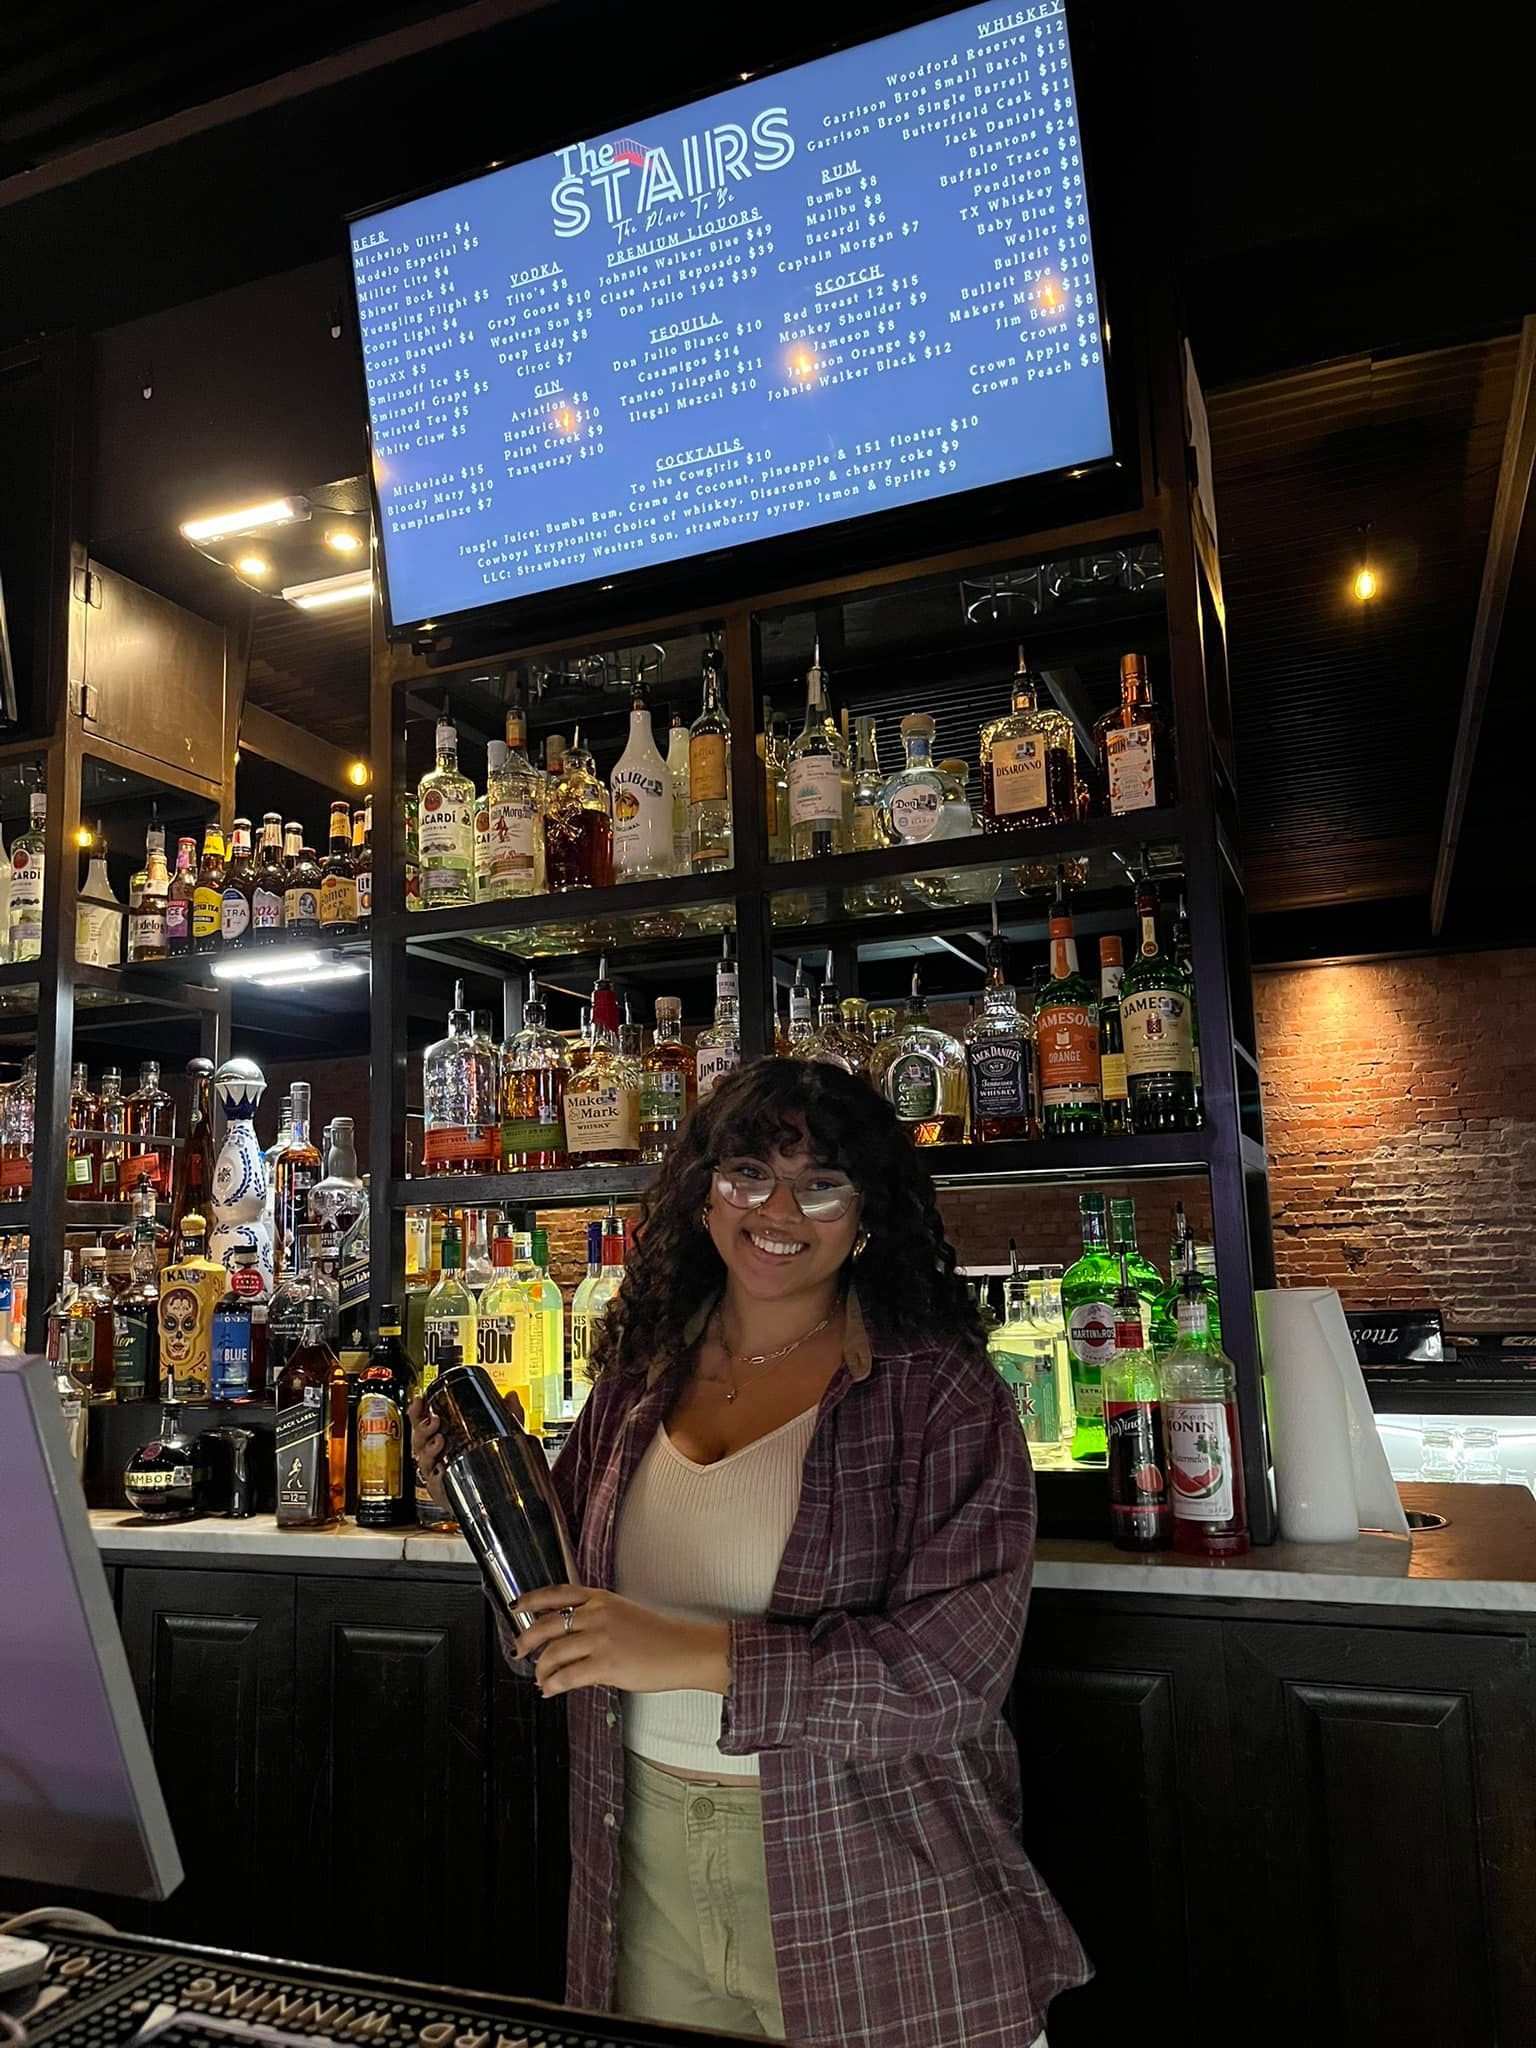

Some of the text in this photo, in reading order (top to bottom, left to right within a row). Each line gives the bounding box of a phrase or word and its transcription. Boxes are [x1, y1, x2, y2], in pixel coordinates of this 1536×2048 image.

[977, 0, 1063, 38] WHISKEY
[886, 20, 1064, 87] Woodford Reserve $12
[823, 39, 1065, 127] Garrison Bros Small Batch $15
[945, 96, 1072, 147] Jack Daniels $8
[551, 107, 795, 238] STAIRS
[554, 141, 615, 181] The
[821, 160, 861, 184] RUM
[940, 135, 1077, 187] Buffalo Trace $8
[806, 175, 877, 207] Bumbu $8
[806, 193, 882, 226] Malibu $8
[959, 174, 1081, 221] TX Whiskey $8
[612, 218, 638, 245] The
[691, 191, 712, 219] To
[716, 188, 736, 210] Be
[806, 211, 886, 245] Bacardi $6
[1004, 214, 1085, 247] Weller $8
[353, 231, 388, 251] BEER
[355, 221, 470, 268] Michelob Ultra $4
[599, 223, 772, 288] Johnnie Walker Blue $49
[607, 208, 761, 266] PREMIUM LIQUORS
[778, 220, 919, 273] Captain Morgan $7
[356, 237, 479, 286] Modelo Especial $5
[510, 262, 562, 287] VODKA
[600, 242, 774, 305] Clase Azul Reposado $39
[815, 264, 882, 295] SCOTCH
[358, 265, 449, 303] Miller Lite $4
[360, 281, 455, 320] Shiner Bock $4
[506, 278, 568, 306] Tito's $8
[783, 274, 918, 324] Red Breast 12 $15
[488, 289, 591, 330] Grey Goose $10
[490, 308, 592, 348] Western Son $5
[649, 312, 721, 343] TEQUILA
[779, 291, 927, 343] Monkey Shoulder $9
[638, 345, 739, 383] Casamigos $14
[969, 332, 1098, 376] Crown Apple $8
[534, 380, 562, 398] GIN
[619, 357, 762, 407] Tanteo Jalapeño $11
[629, 378, 756, 422] Ilegal Mezcal $10
[372, 405, 469, 441] Twisted Tea $5
[511, 391, 588, 422] Aviation $8
[375, 424, 466, 457] White Claw $5
[504, 424, 603, 461] Paint Creek $9
[656, 438, 743, 471] COCKTAILS
[393, 463, 484, 497] Michelada $15
[630, 449, 771, 494] To the Cowgirls $10
[483, 459, 956, 584] LLC: Strawberry Western Son, strawberry syrup, lemon & Sprite $9
[996, 759, 1041, 777] DISARONNO
[699, 1061, 715, 1081] JIM
[972, 1048, 990, 1065] JACK
[1049, 1051, 1081, 1063] ORANGE
[581, 1106, 618, 1119] Mark
[224, 1348, 248, 1361] BLUE
